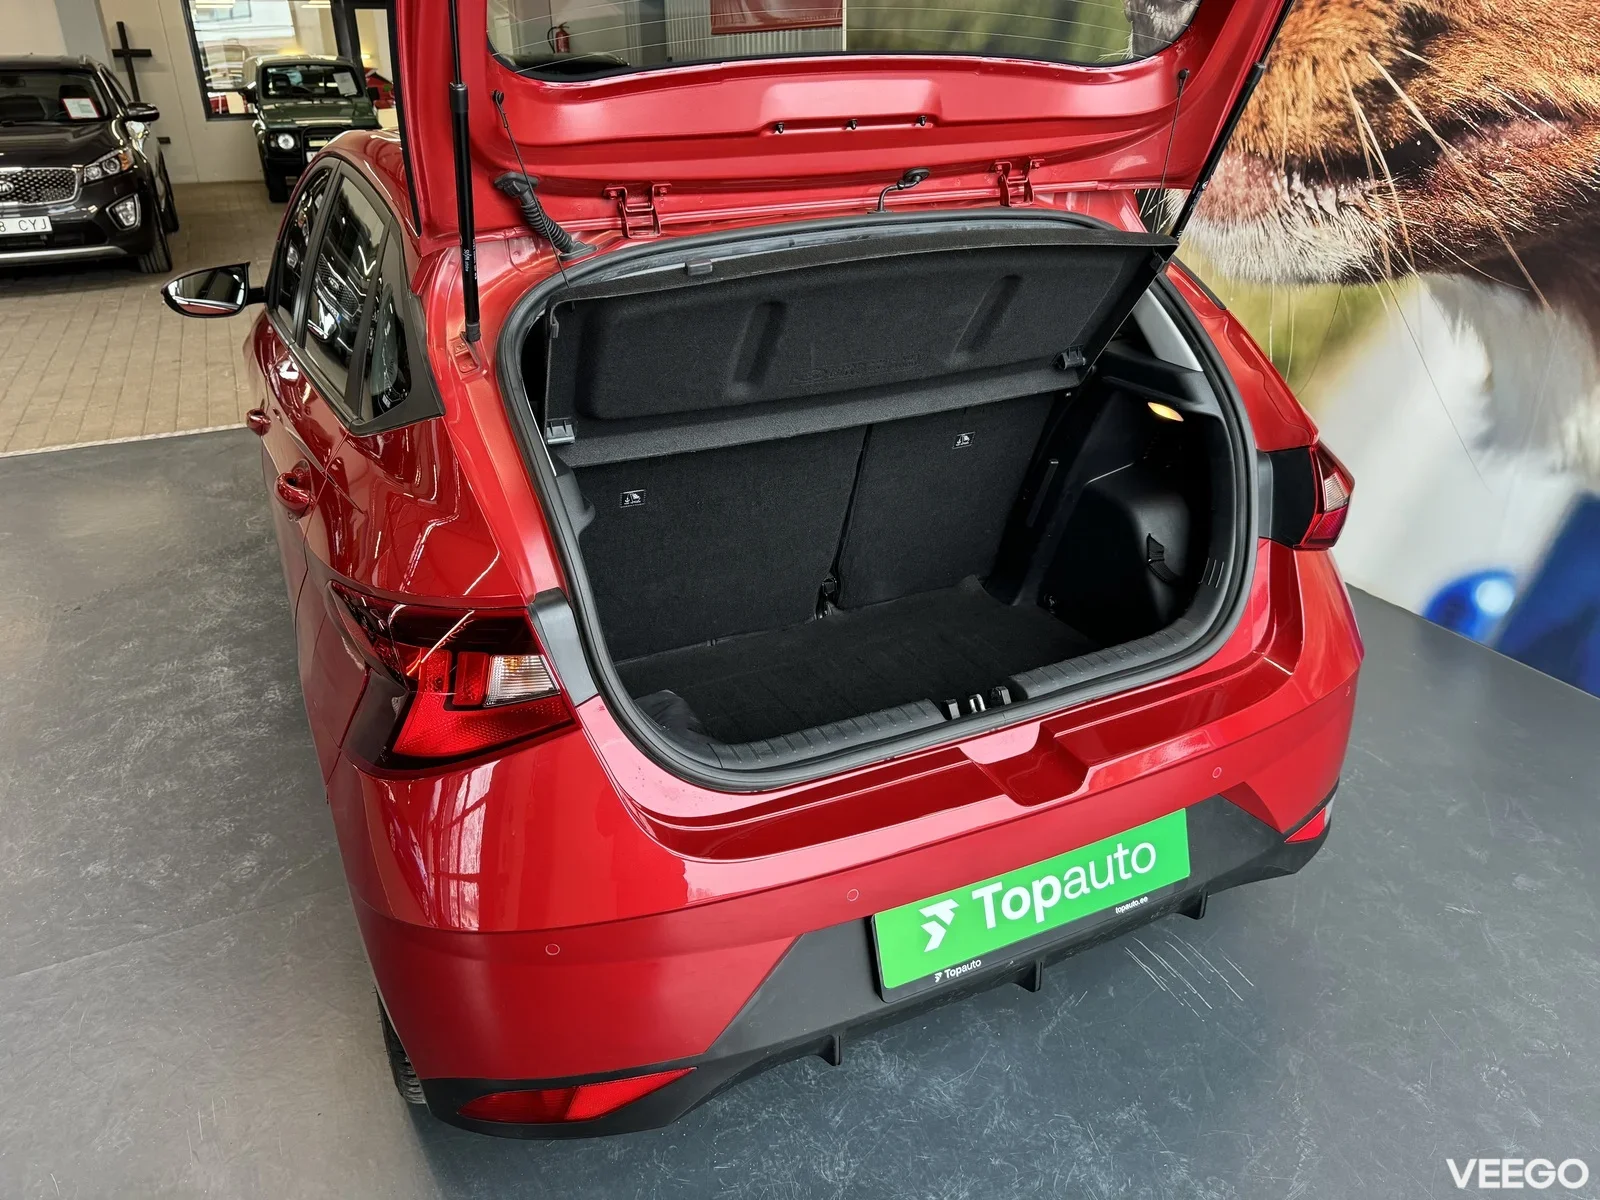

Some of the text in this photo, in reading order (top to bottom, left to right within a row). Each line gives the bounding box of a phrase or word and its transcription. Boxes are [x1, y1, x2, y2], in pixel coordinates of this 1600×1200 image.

[18, 219, 47, 231] CYJ
[971, 842, 1157, 929] Topauto
[944, 959, 982, 979] Topauto
